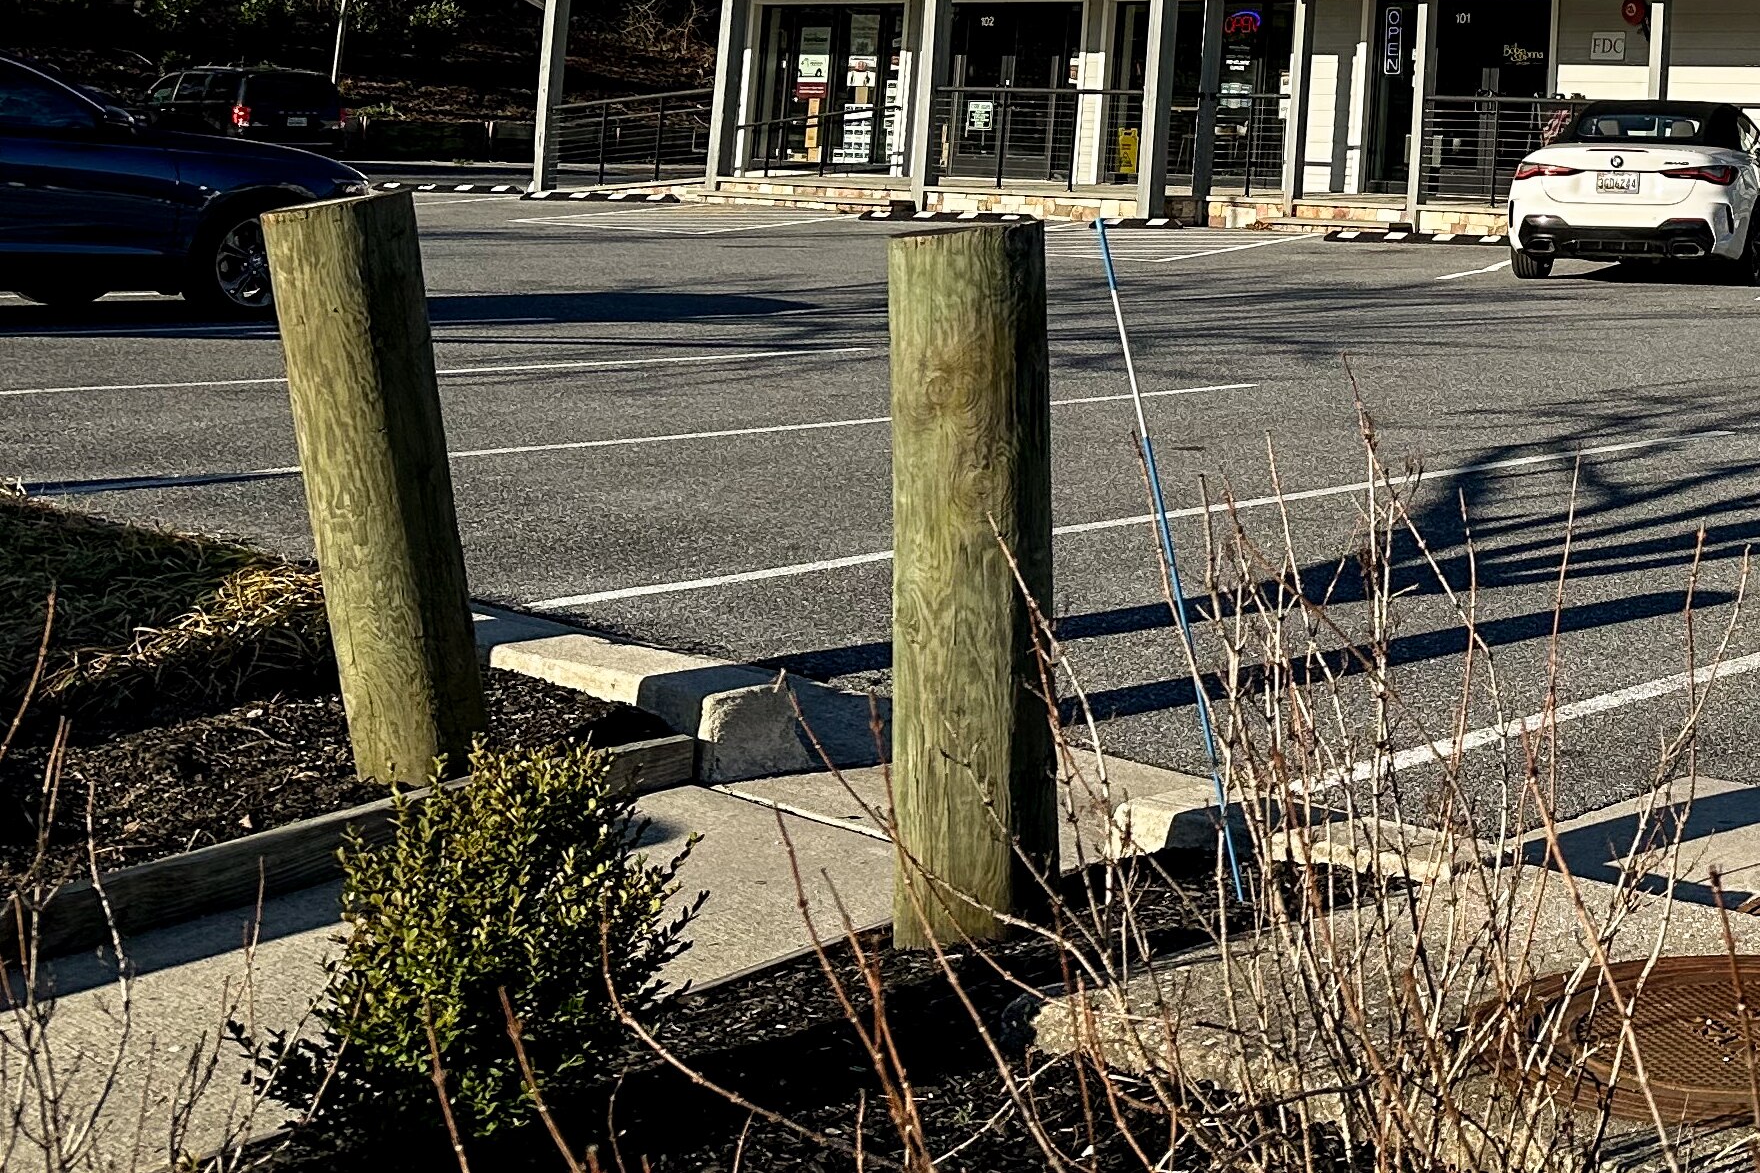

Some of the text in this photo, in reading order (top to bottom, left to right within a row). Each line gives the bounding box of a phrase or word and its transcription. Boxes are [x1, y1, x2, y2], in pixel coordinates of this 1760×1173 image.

[980, 16, 995, 27] 102
[1455, 12, 1471, 24] 101
[1387, 10, 1400, 71] OPEN
[1592, 37, 1624, 55] FDC
